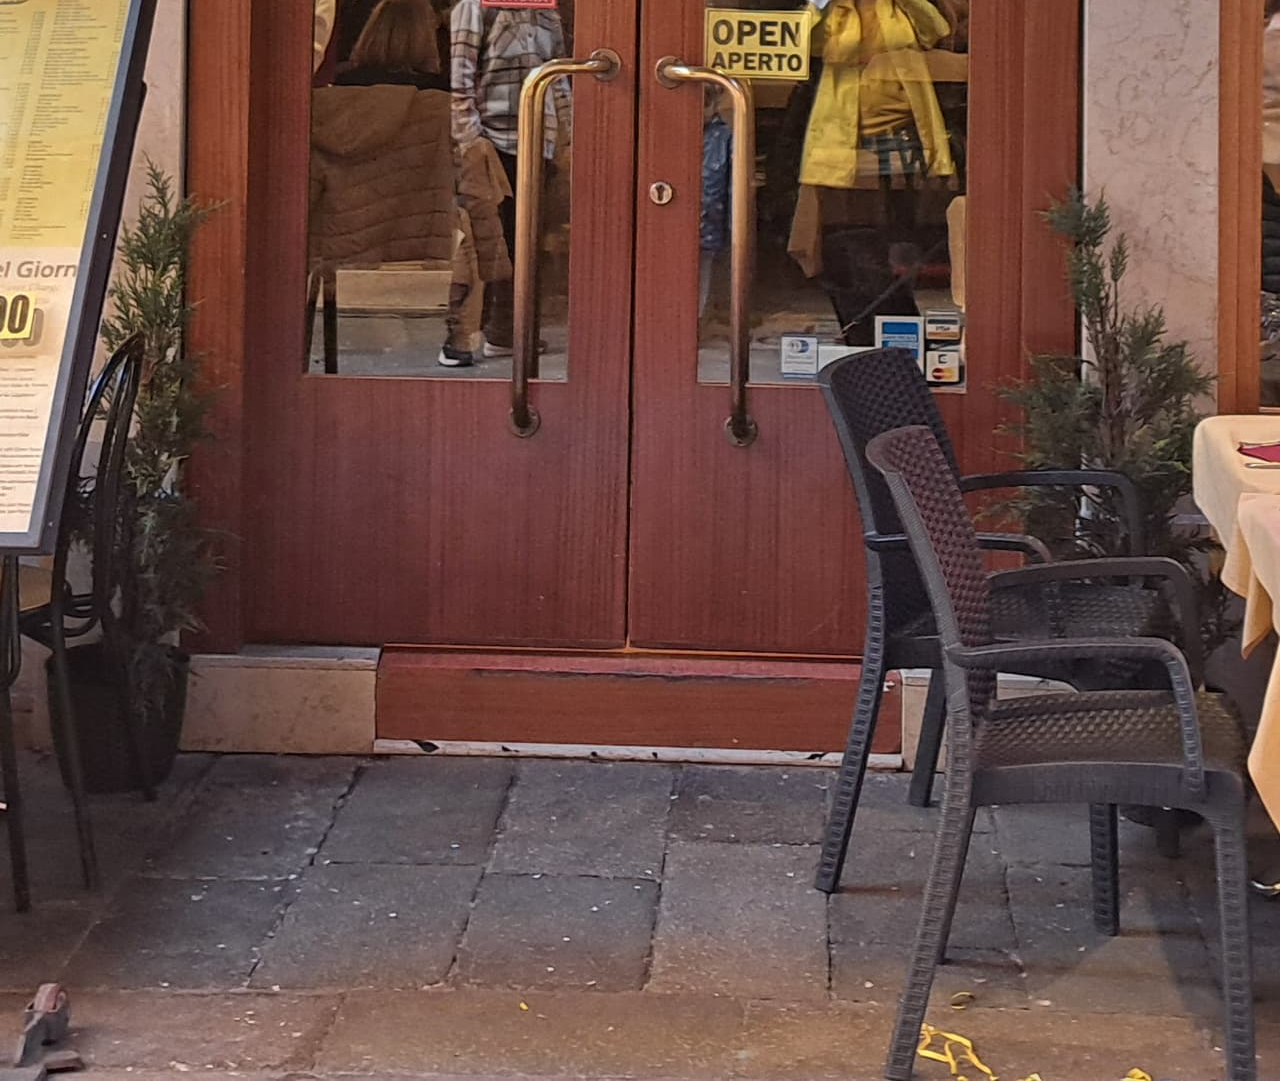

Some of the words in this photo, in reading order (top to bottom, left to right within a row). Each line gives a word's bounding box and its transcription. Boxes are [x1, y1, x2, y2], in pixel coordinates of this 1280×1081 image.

[712, 20, 801, 48] OPEN
[711, 52, 803, 73] APERTO
[16, 260, 78, 279] Giorn
